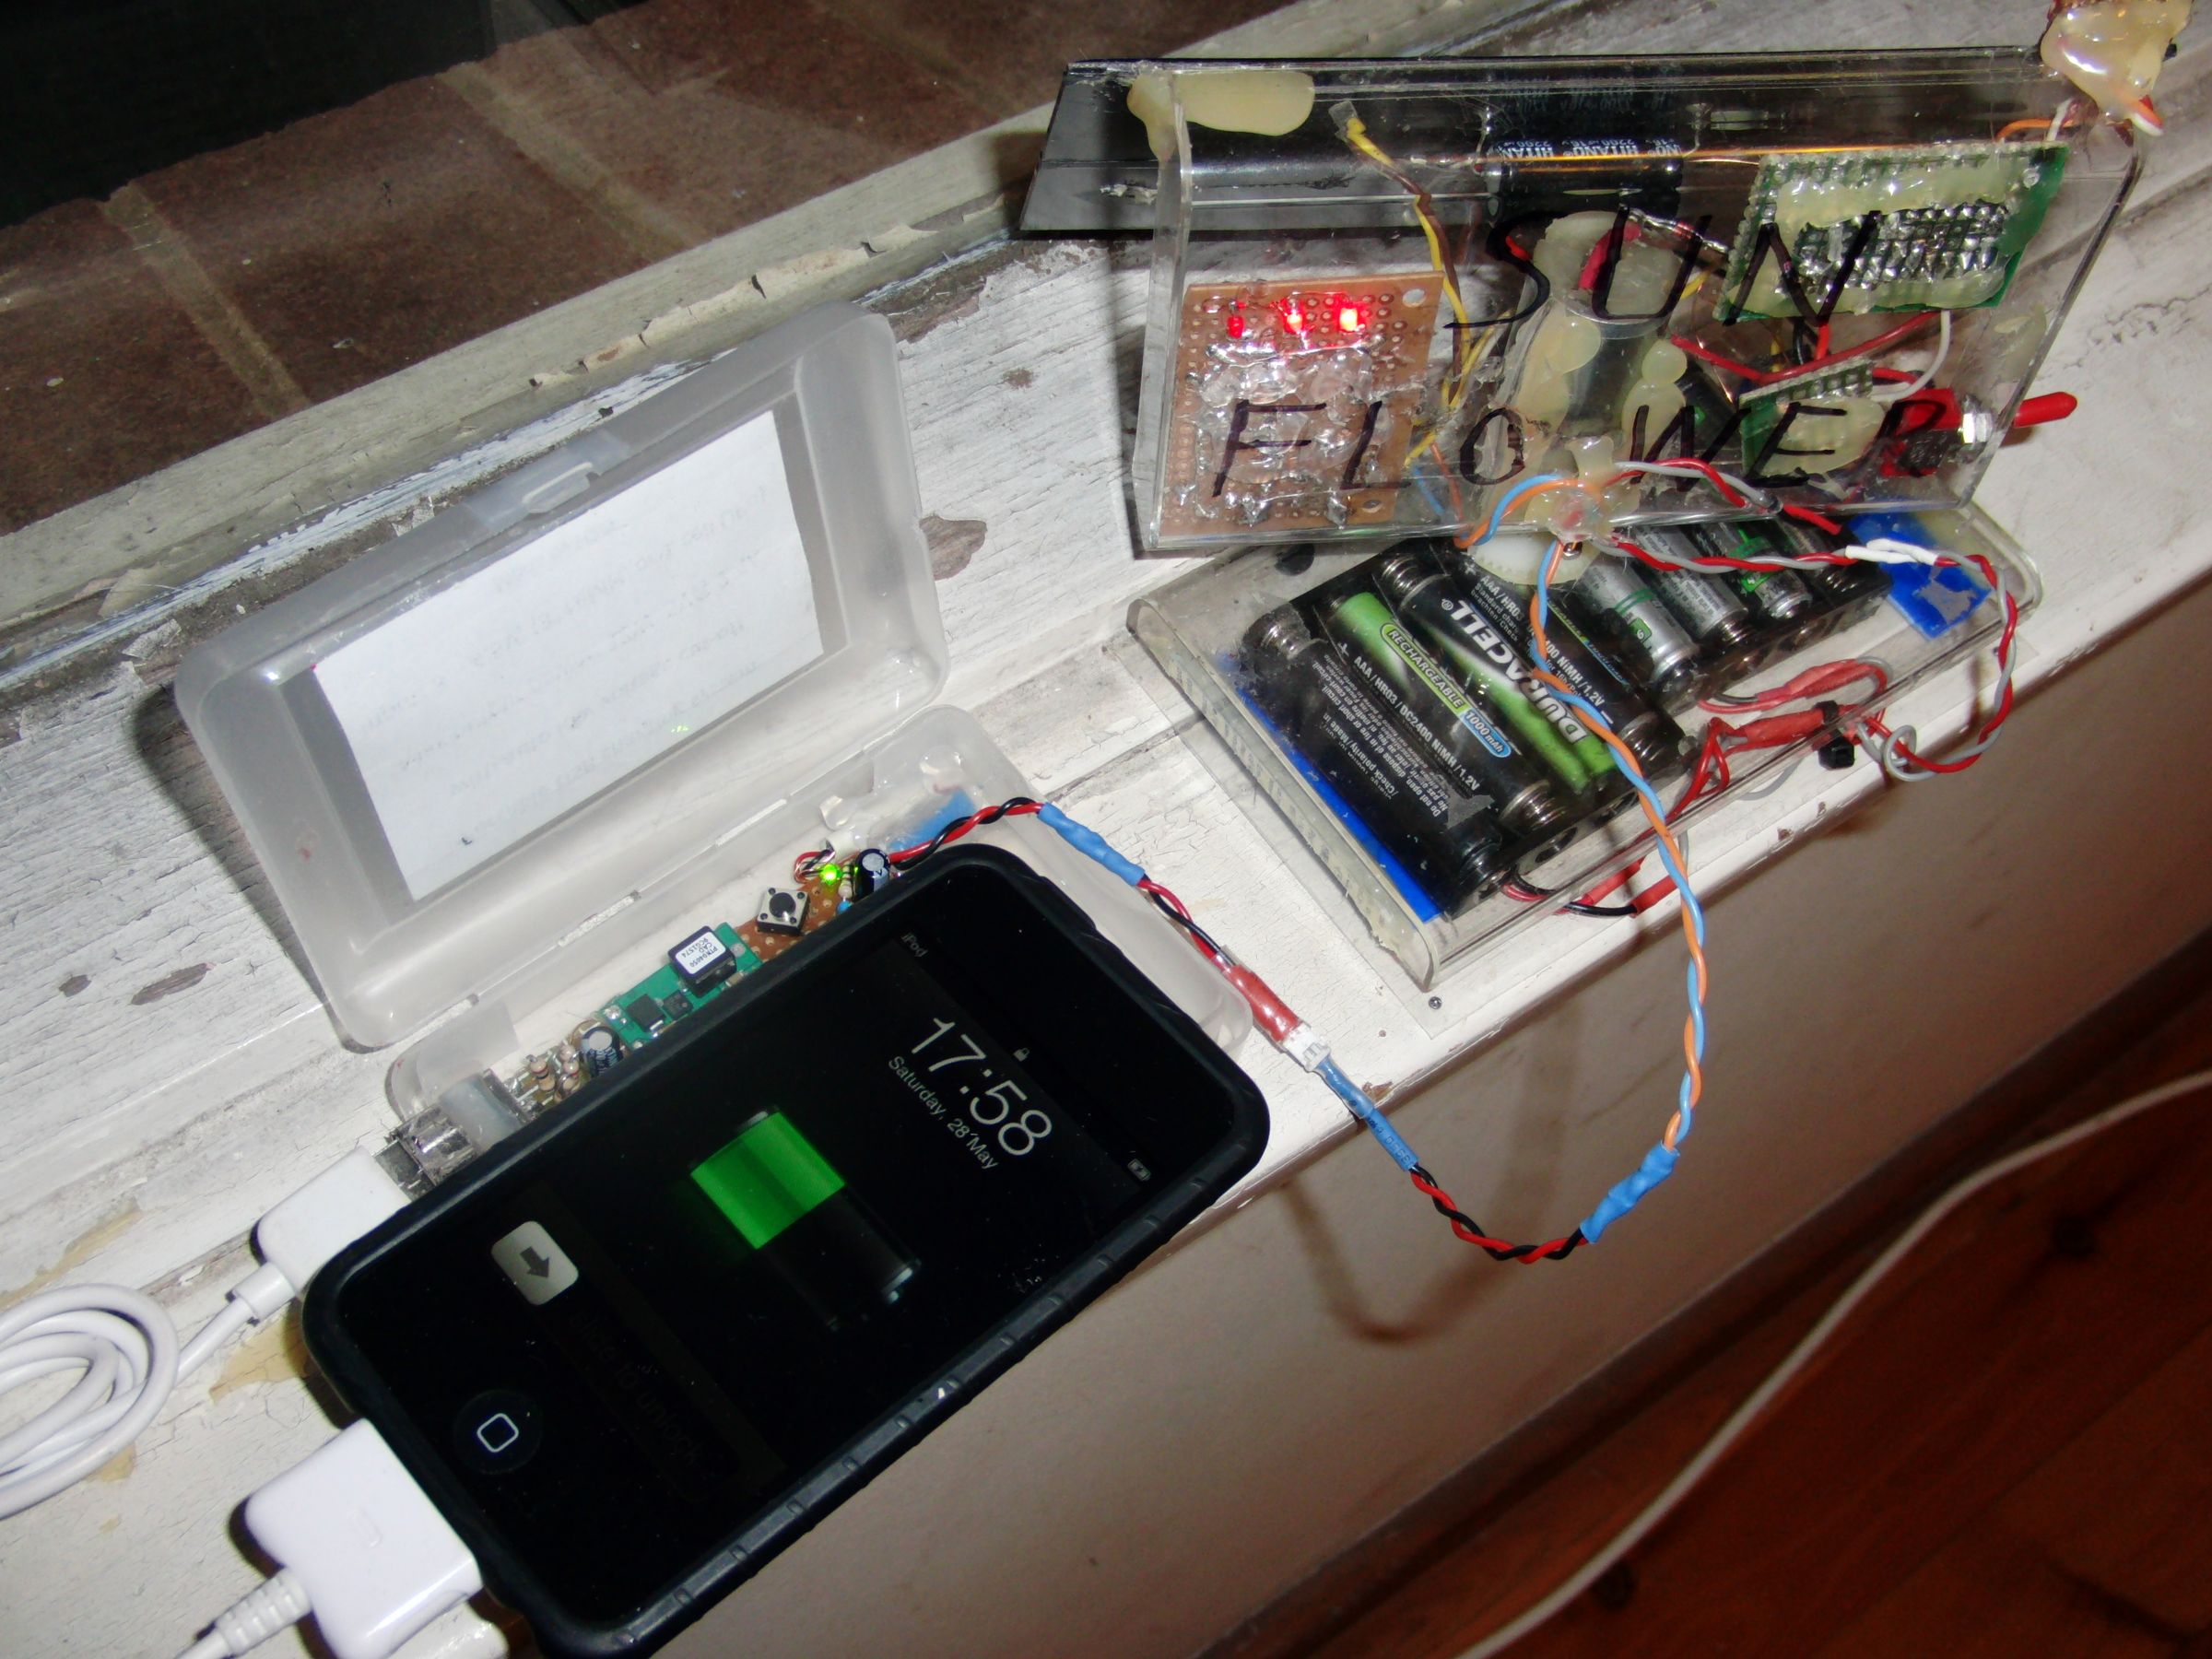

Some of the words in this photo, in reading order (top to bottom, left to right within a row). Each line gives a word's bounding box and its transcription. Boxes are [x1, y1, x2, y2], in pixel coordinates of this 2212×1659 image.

[1444, 205, 1883, 329] SUN
[1211, 399, 1950, 498] FLOWER
[1387, 628, 1465, 710] RECHARGEABLE
[1337, 703, 1356, 722] short
[1398, 705, 1433, 742] DC2400
[1430, 738, 1458, 768] NiMH
[1381, 750, 1407, 778] dispose
[1418, 793, 1433, 806] not
[1429, 804, 1441, 817] Do
[698, 941, 712, 954] CAD
[900, 928, 928, 959] iPod
[912, 1018, 1053, 1156] 17:58
[888, 1056, 947, 1121] Saturday,
[947, 1118, 971, 1139] 28
[966, 1135, 999, 1171] May
